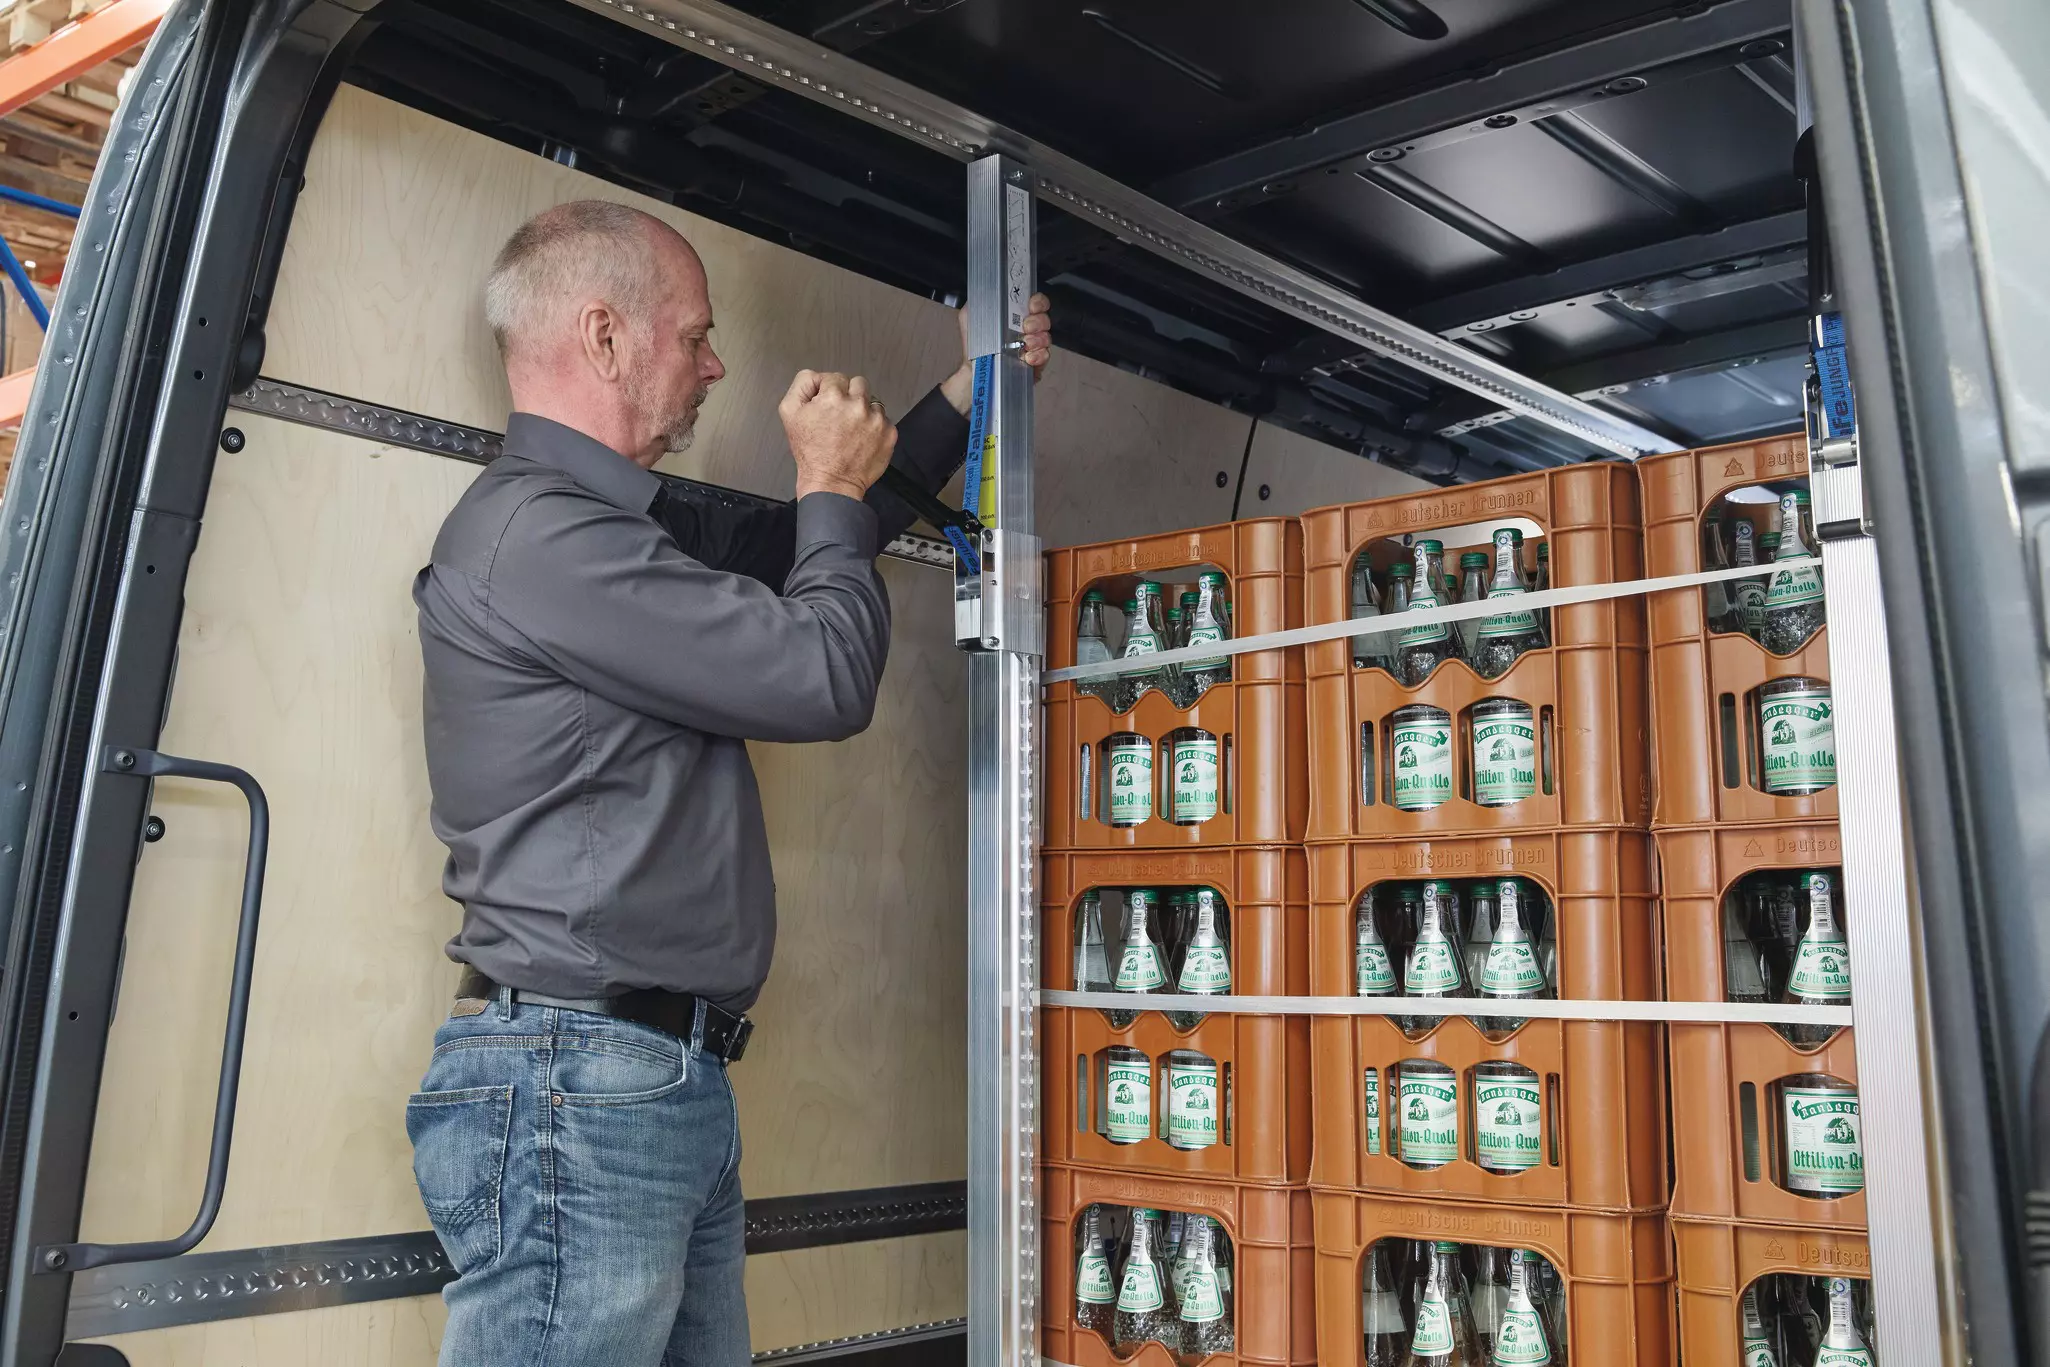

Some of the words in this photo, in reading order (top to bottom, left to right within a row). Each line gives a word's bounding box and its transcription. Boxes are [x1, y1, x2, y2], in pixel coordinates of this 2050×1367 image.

[972, 387, 985, 450] allsafe
[1391, 500, 1466, 525] Deutscher
[1472, 489, 1534, 513] Brunnen
[1391, 850, 1472, 869] Deutscher
[1476, 848, 1545, 868] Brunnen
[1399, 1209, 1478, 1232] Deutscher
[1484, 1215, 1551, 1237] Brunnen
